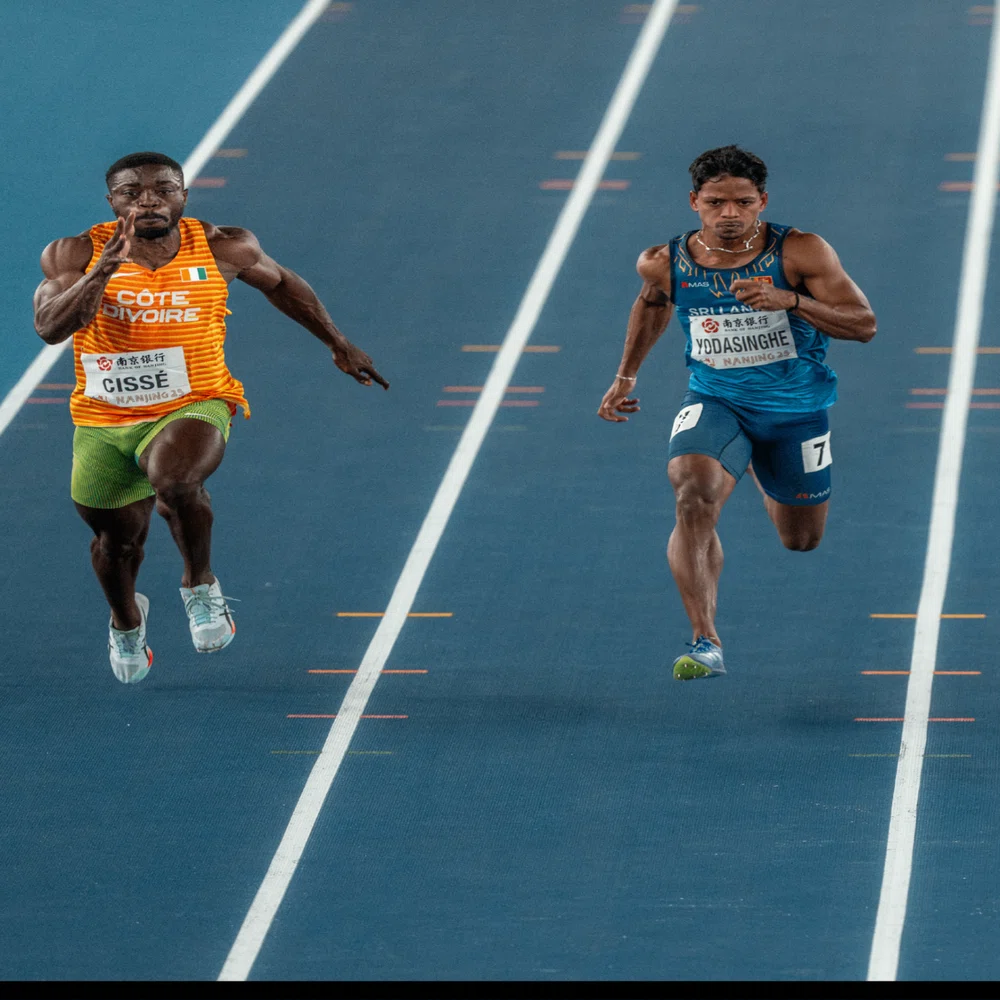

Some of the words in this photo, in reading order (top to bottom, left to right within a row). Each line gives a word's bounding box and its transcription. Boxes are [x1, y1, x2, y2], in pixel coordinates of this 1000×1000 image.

[117, 288, 190, 307] CÔTE
[688, 306, 714, 316] SRI
[696, 330, 790, 355] YODASINGHE
[723, 354, 775, 366] NANJING
[102, 370, 170, 394] CISSÉ
[813, 441, 826, 467] 7
